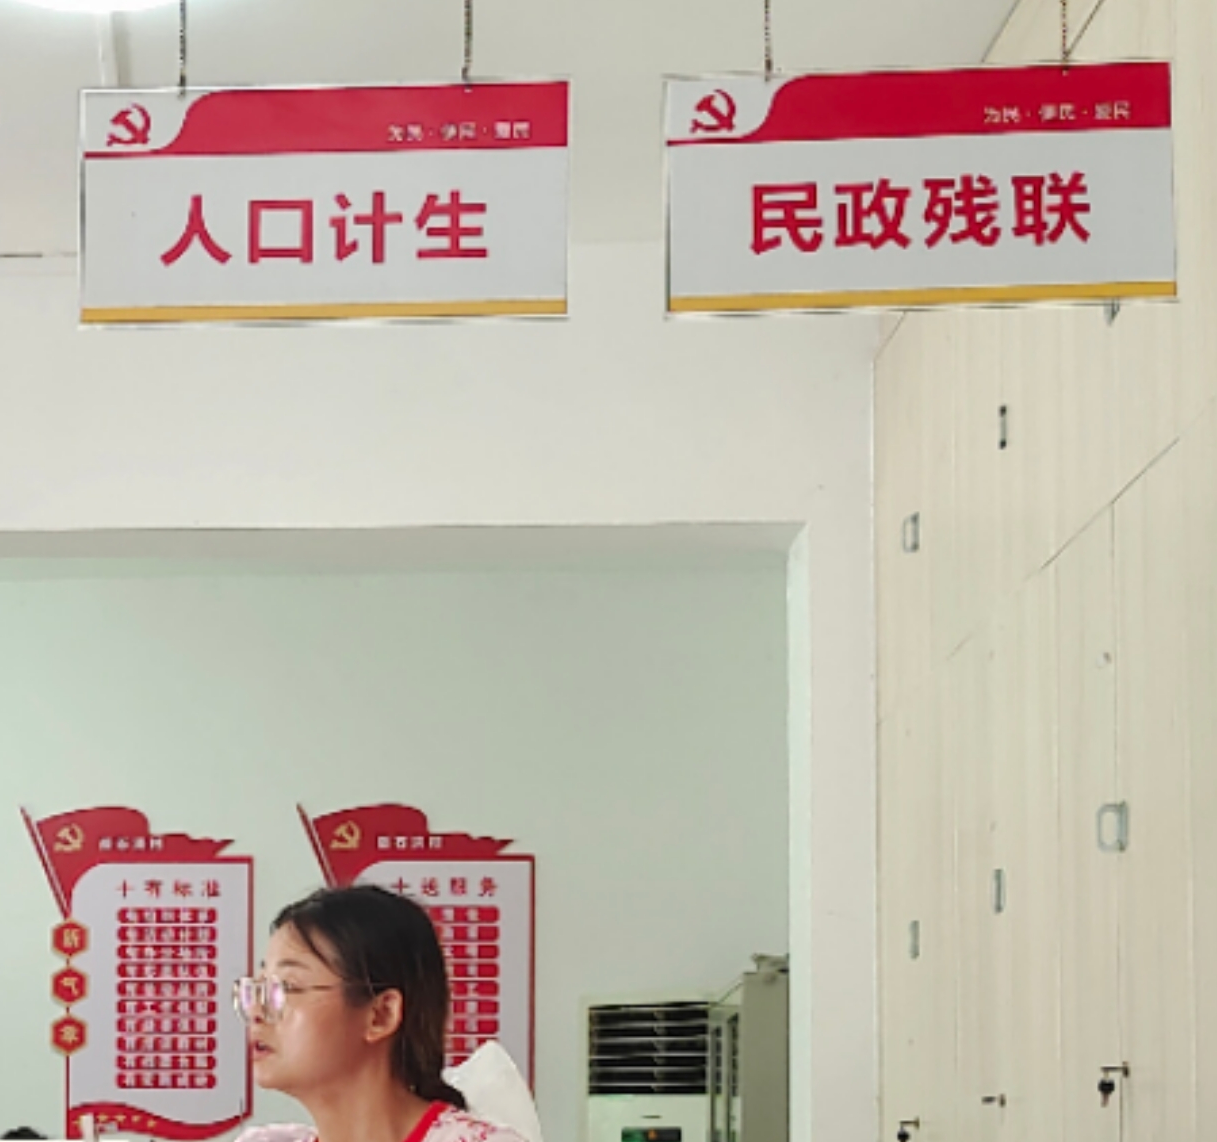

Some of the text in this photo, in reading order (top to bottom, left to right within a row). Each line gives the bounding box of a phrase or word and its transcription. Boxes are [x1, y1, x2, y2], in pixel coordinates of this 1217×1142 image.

[160, 190, 489, 267] 人口计生
[750, 171, 1091, 255] 民政残联
[116, 879, 221, 899] 十有标准
